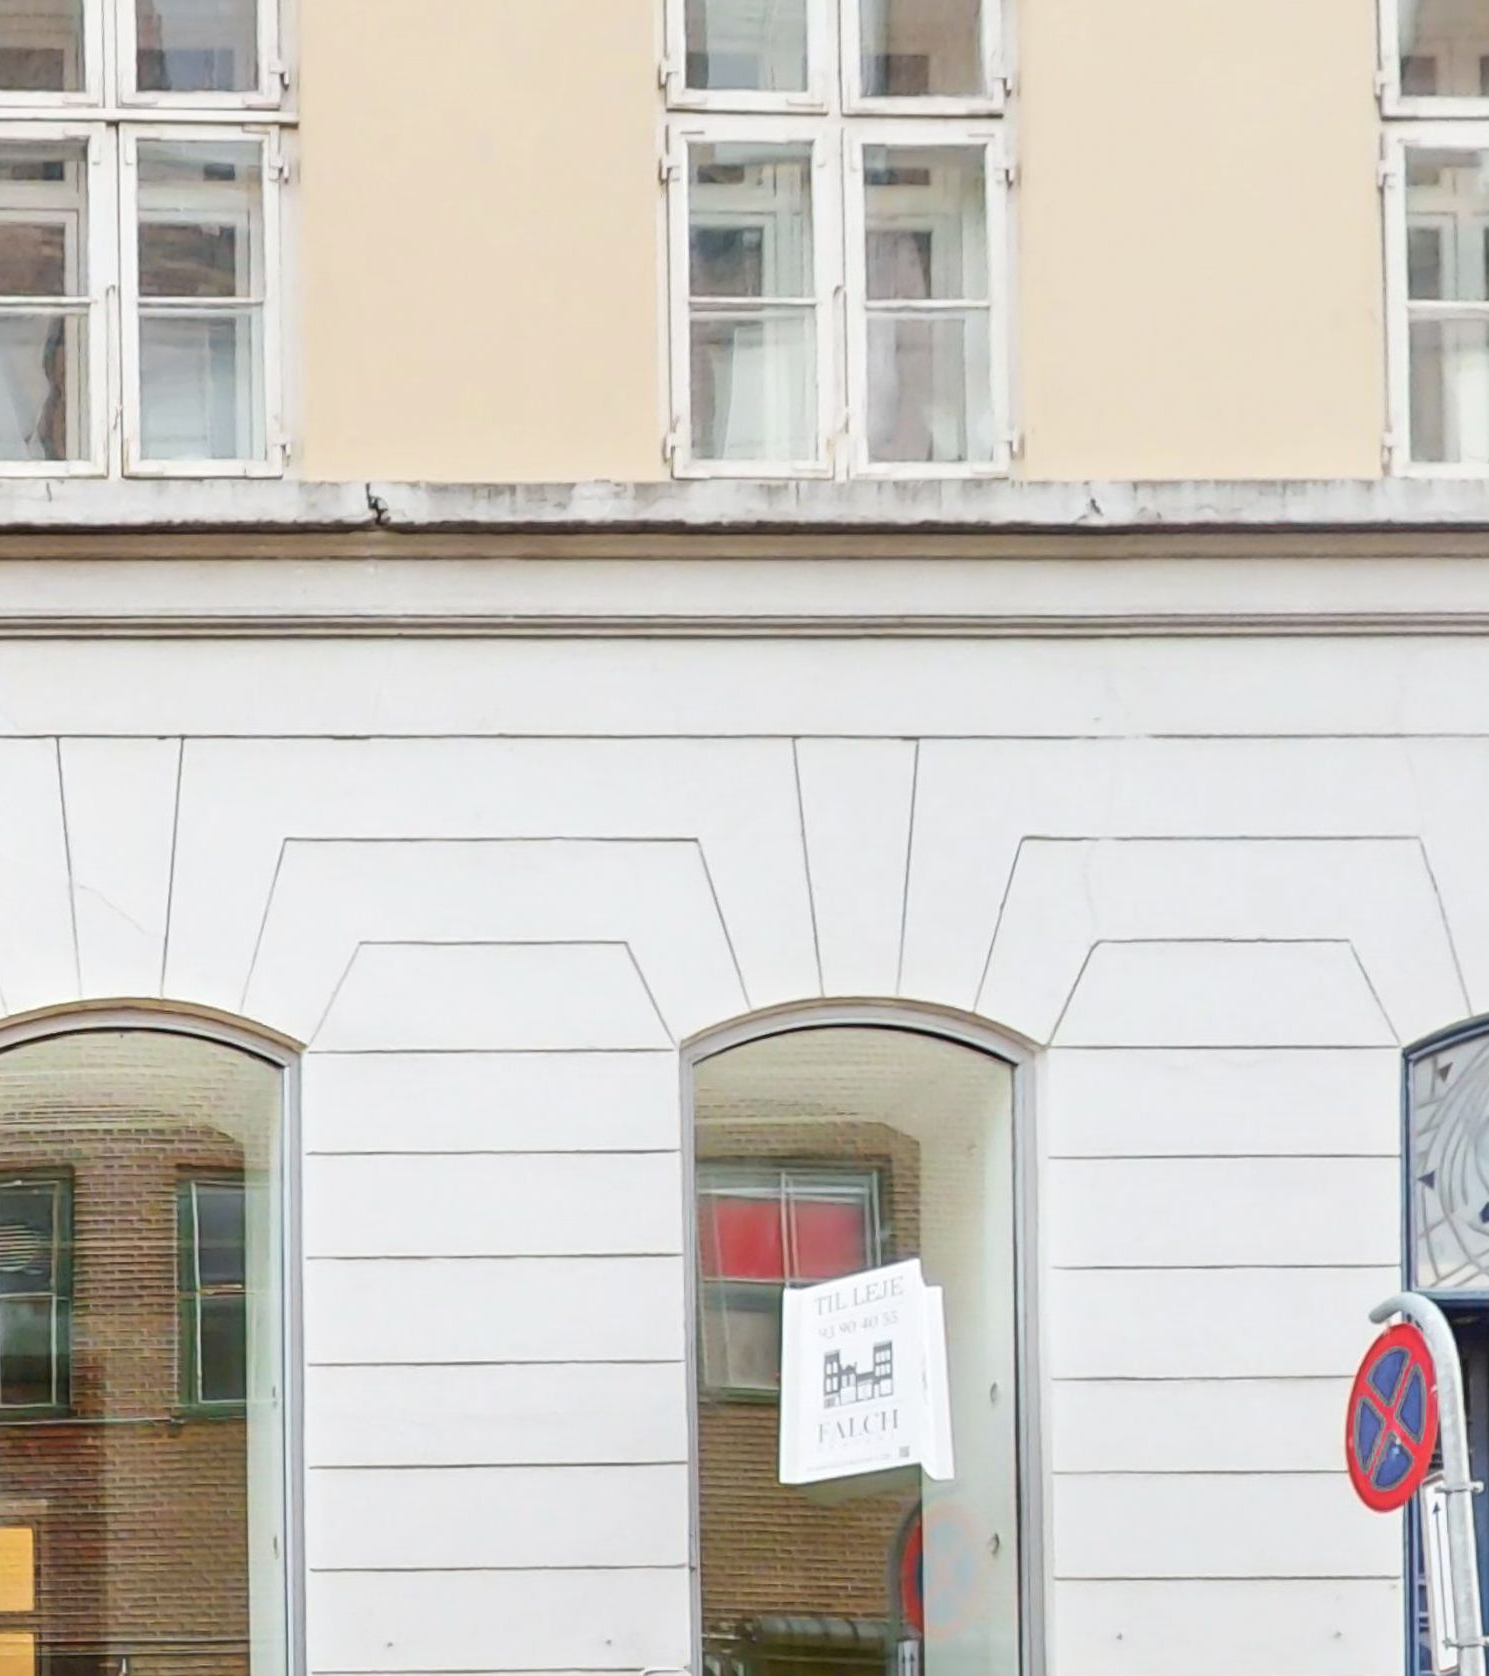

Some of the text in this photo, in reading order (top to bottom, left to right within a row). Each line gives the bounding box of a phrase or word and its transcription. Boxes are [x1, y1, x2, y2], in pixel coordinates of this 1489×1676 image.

[815, 1275, 905, 1316] TIL LEJE
[839, 1319, 858, 1335] 90
[861, 1315, 879, 1330] 40
[817, 1409, 899, 1443] FALCH
